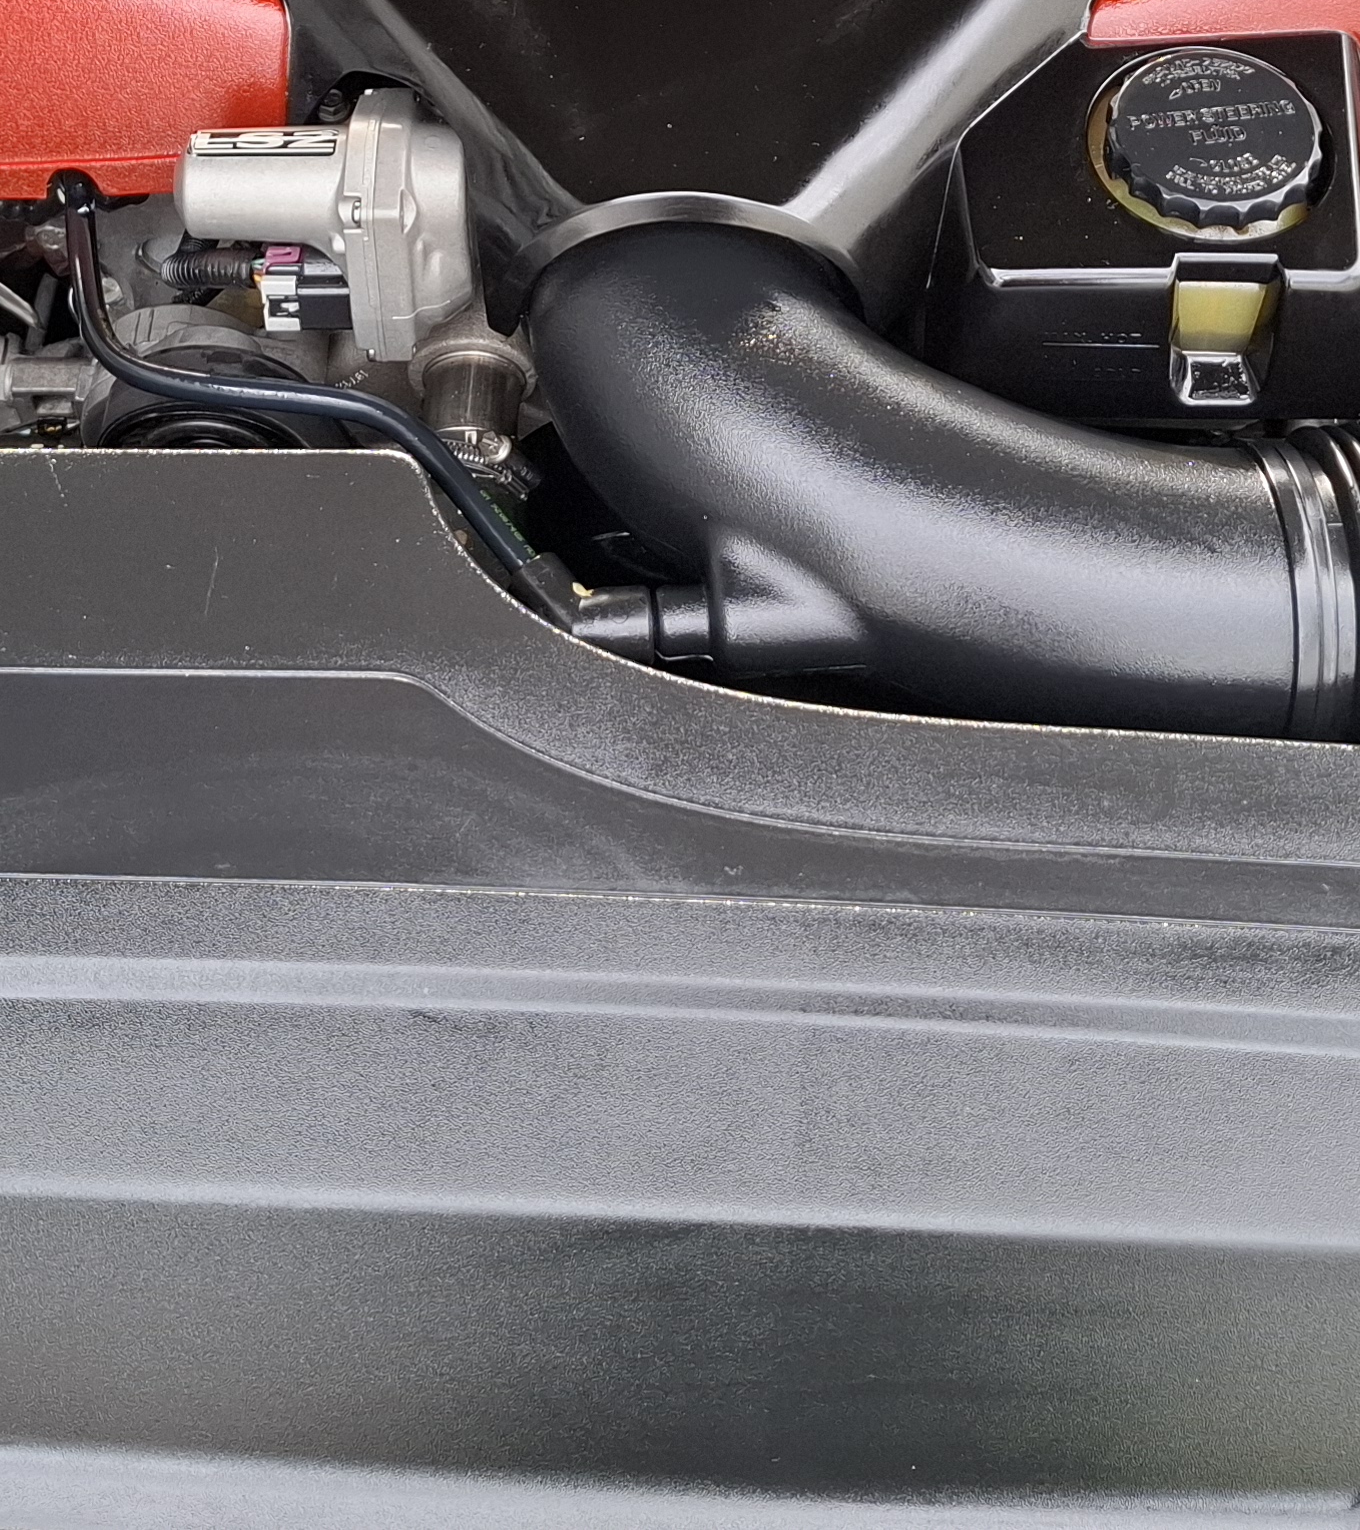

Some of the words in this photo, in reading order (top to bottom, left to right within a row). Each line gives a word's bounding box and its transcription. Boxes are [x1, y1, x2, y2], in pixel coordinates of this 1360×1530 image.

[1126, 109, 1198, 129] POWER
[1199, 99, 1295, 123] STEERING
[193, 125, 340, 155] LS2
[1189, 124, 1246, 145] FLUID
